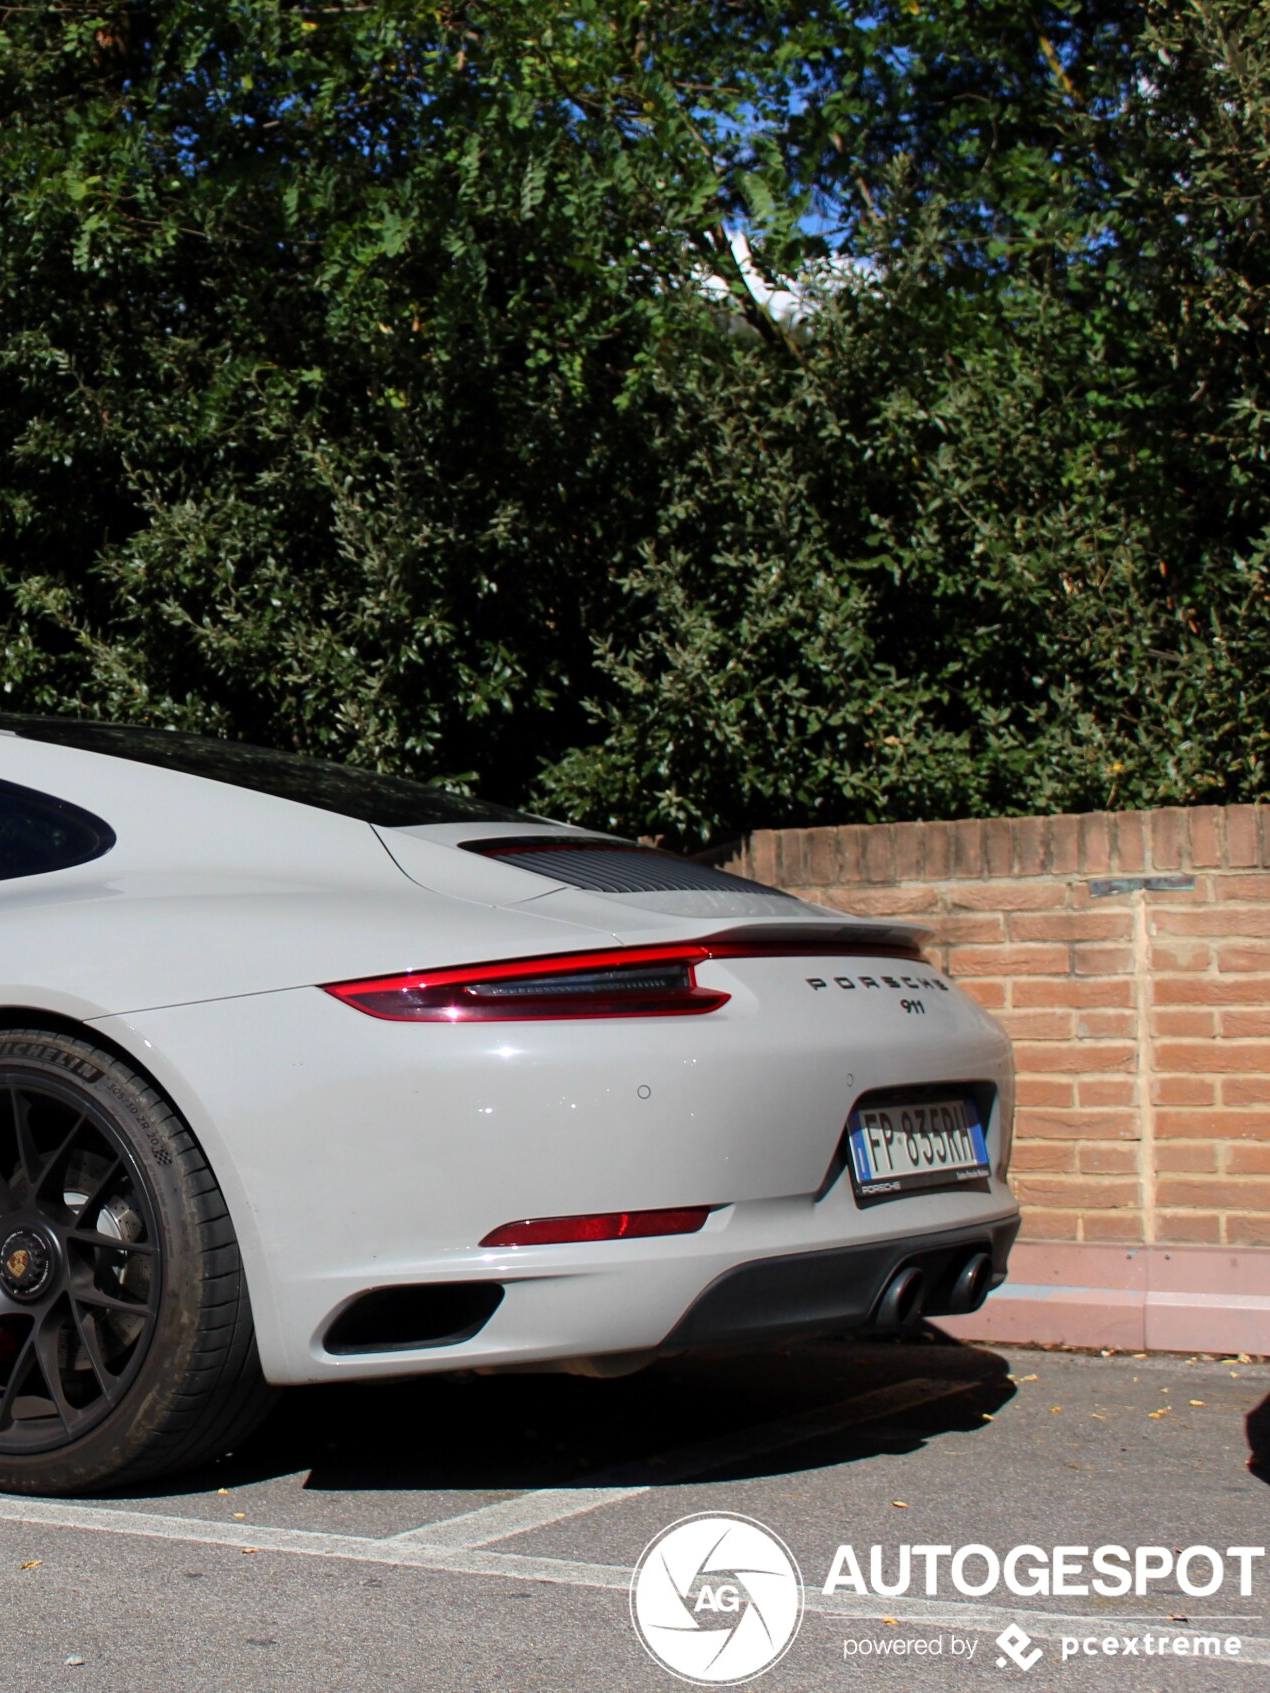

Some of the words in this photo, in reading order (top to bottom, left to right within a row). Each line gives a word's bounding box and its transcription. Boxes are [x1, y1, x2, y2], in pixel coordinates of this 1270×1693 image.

[805, 976, 949, 991] PORSCHE
[900, 999, 925, 1014] 911
[861, 1181, 902, 1195] PORSCHE
